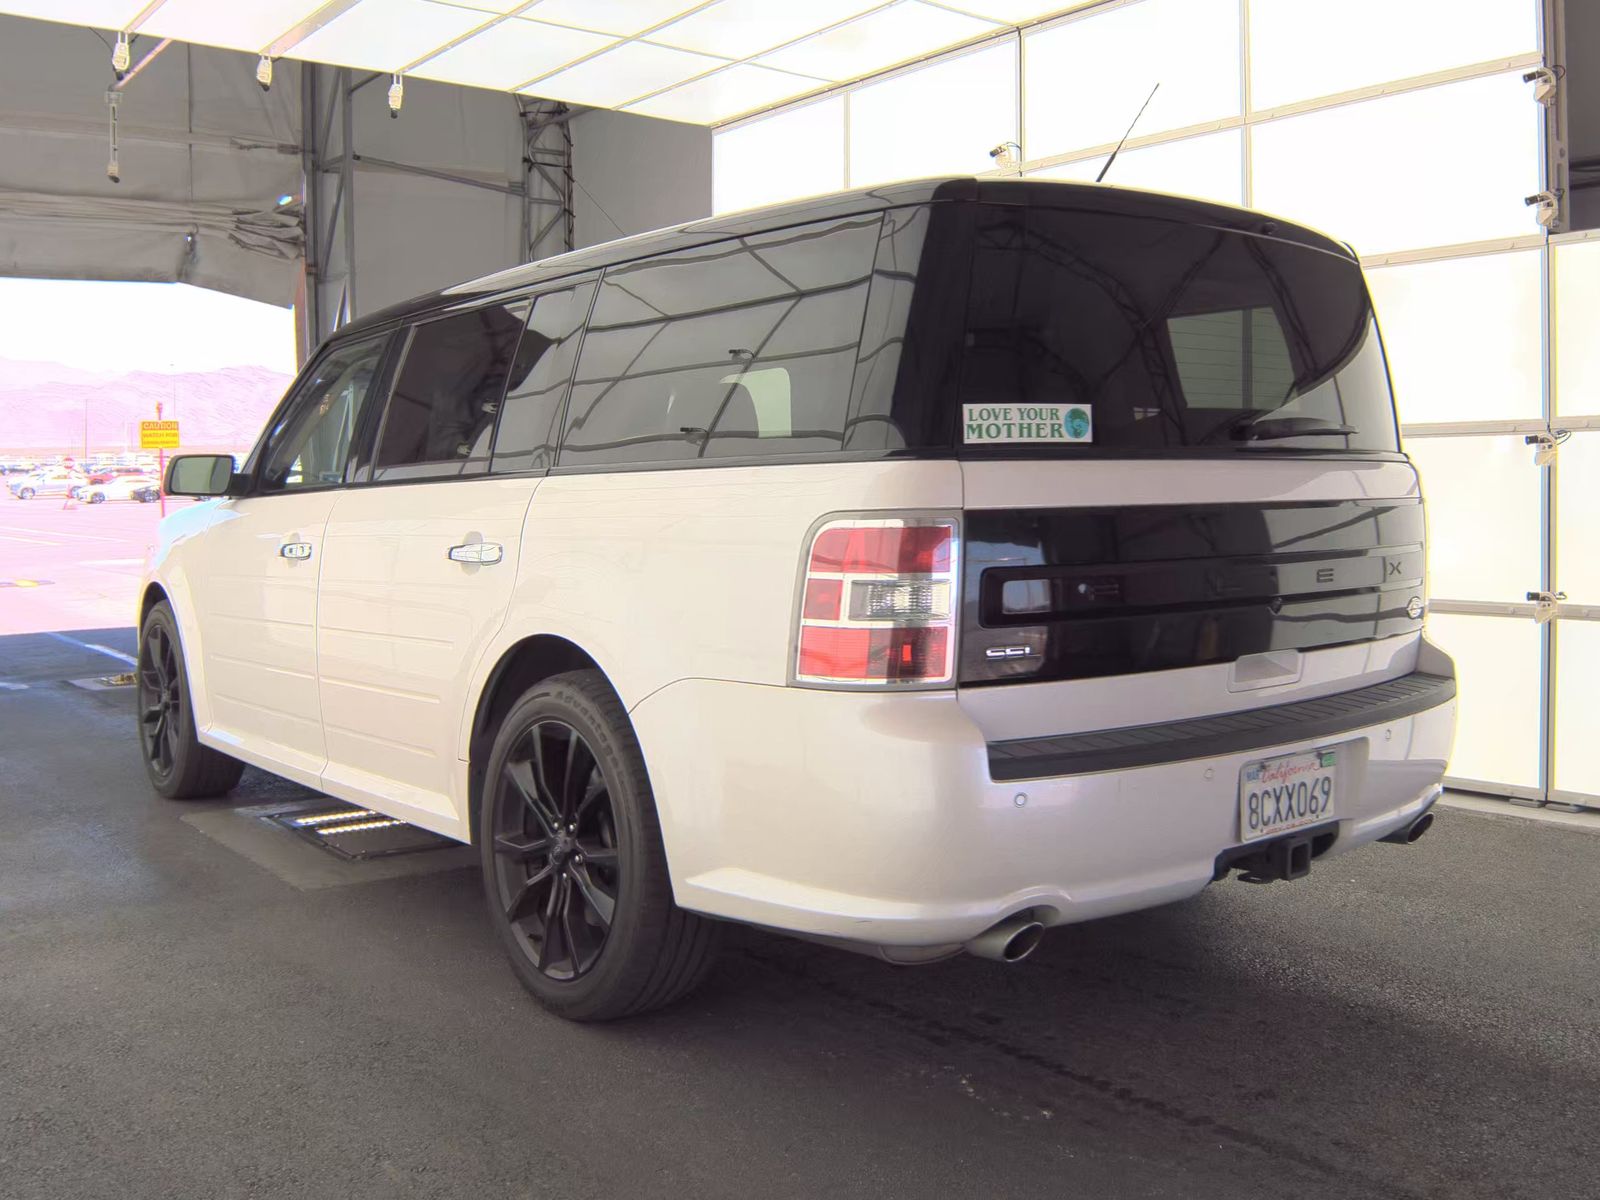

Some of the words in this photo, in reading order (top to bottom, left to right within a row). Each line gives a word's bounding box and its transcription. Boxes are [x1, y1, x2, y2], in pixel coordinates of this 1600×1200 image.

[968, 408, 1013, 421] LOVE
[1017, 408, 1060, 421] YOUR
[143, 422, 177, 430] CAUTION
[966, 423, 1064, 439] MOTHER
[1248, 776, 1332, 830] 8CXX069
